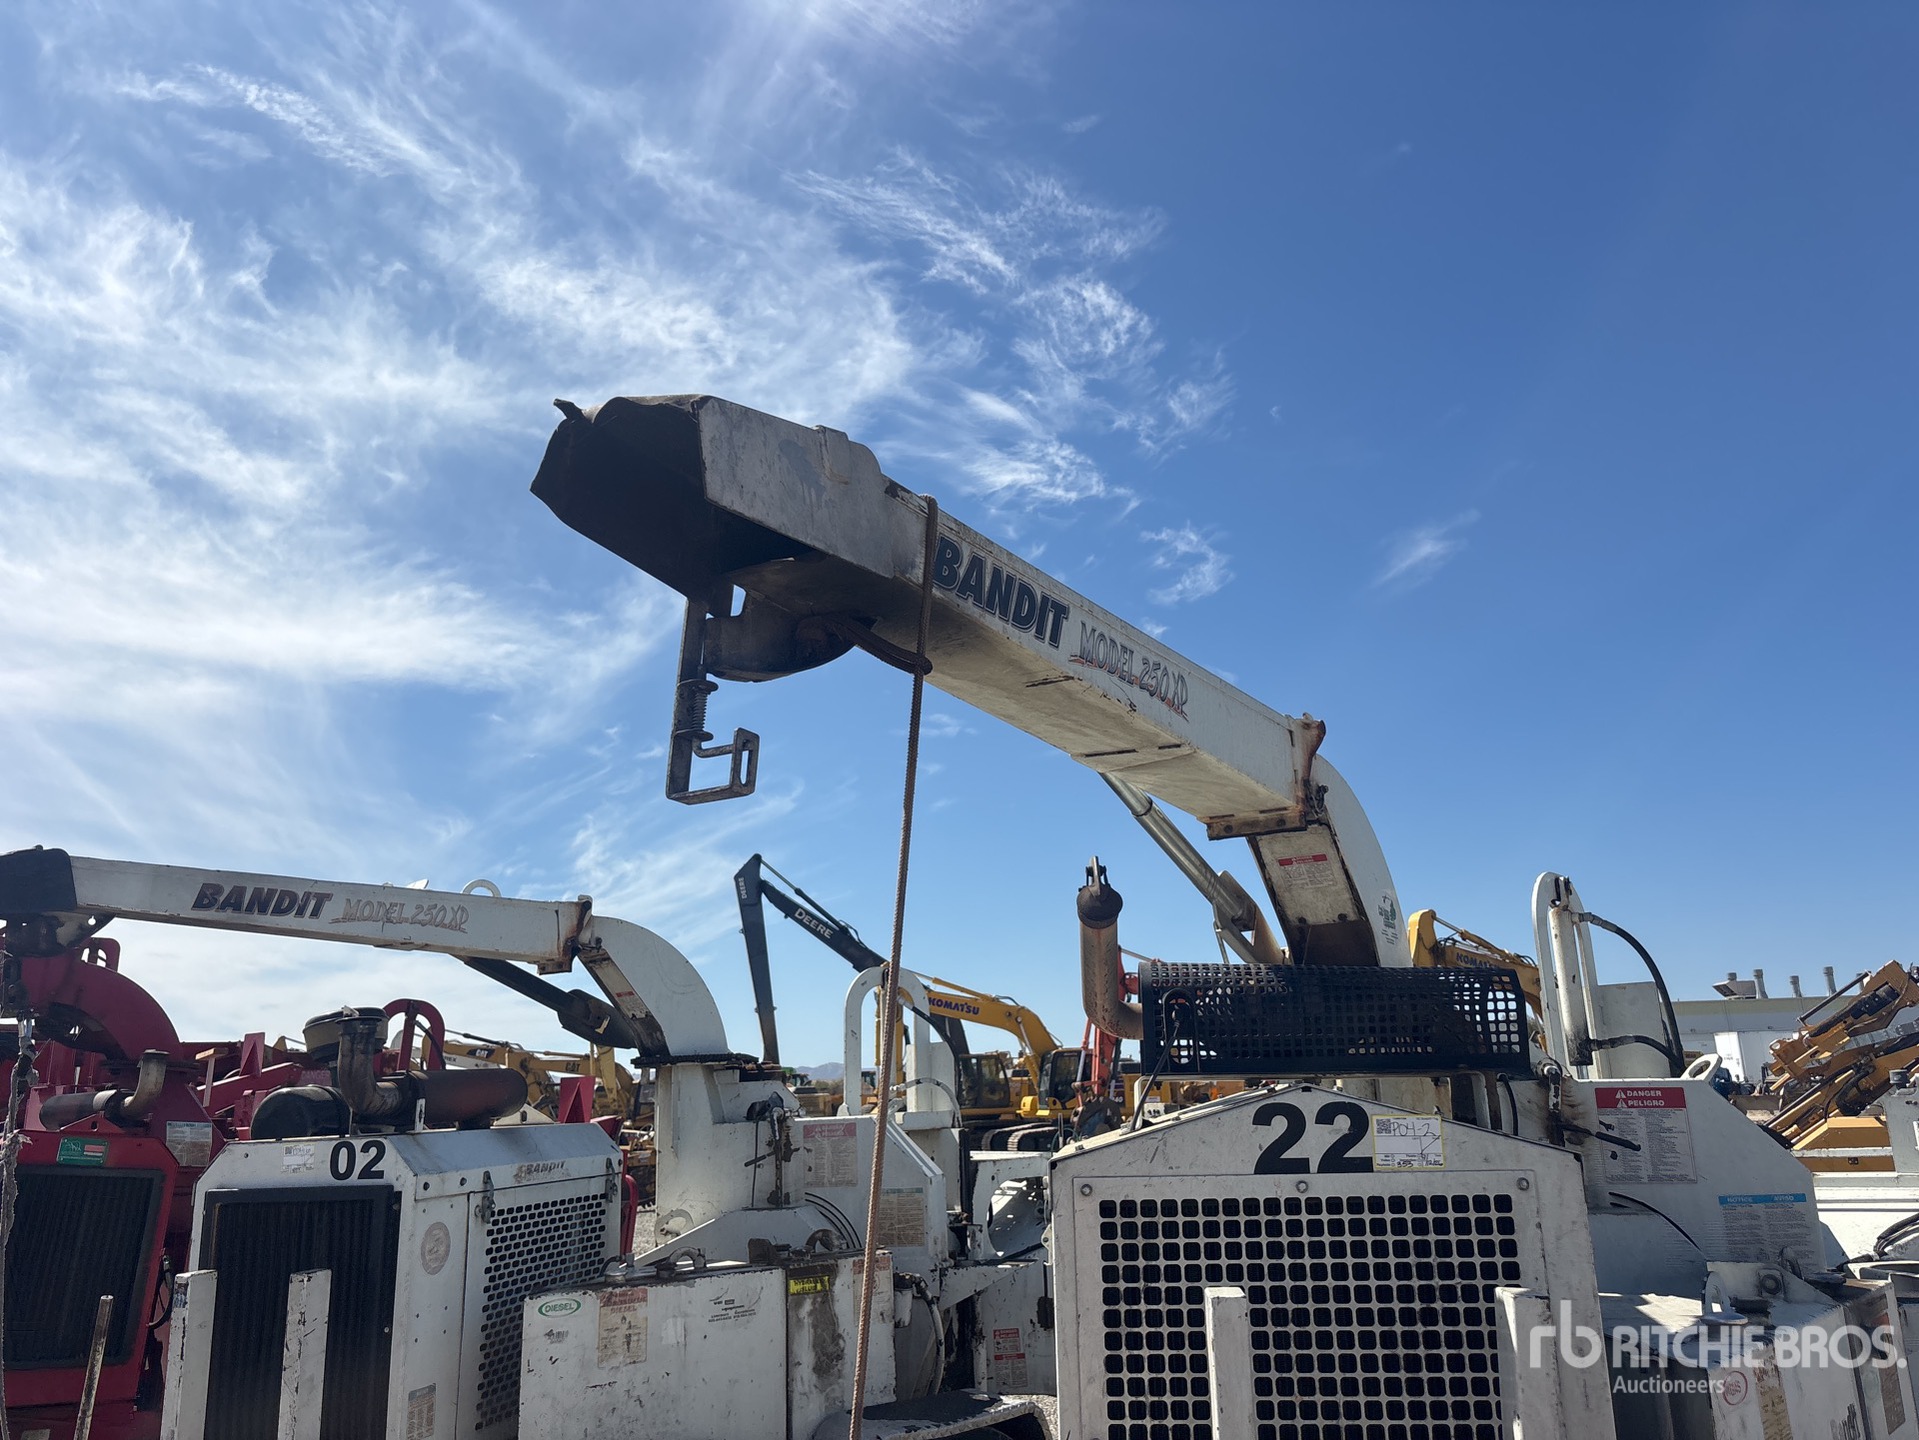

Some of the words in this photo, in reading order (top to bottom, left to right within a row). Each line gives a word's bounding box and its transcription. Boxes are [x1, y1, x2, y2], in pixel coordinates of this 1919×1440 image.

[933, 532, 1070, 648] BANDIT
[1080, 621, 1135, 685] MODEL
[191, 882, 334, 920] BANDIT
[342, 898, 406, 923] MODEL
[794, 908, 834, 939] DEERE
[929, 997, 980, 1015] KOMATSU
[475, 1049, 489, 1059] CAT
[565, 1062, 580, 1072] CAT
[1252, 1101, 1374, 1174] 22
[329, 1139, 387, 1181] 02
[544, 1302, 575, 1313] DIESEL
